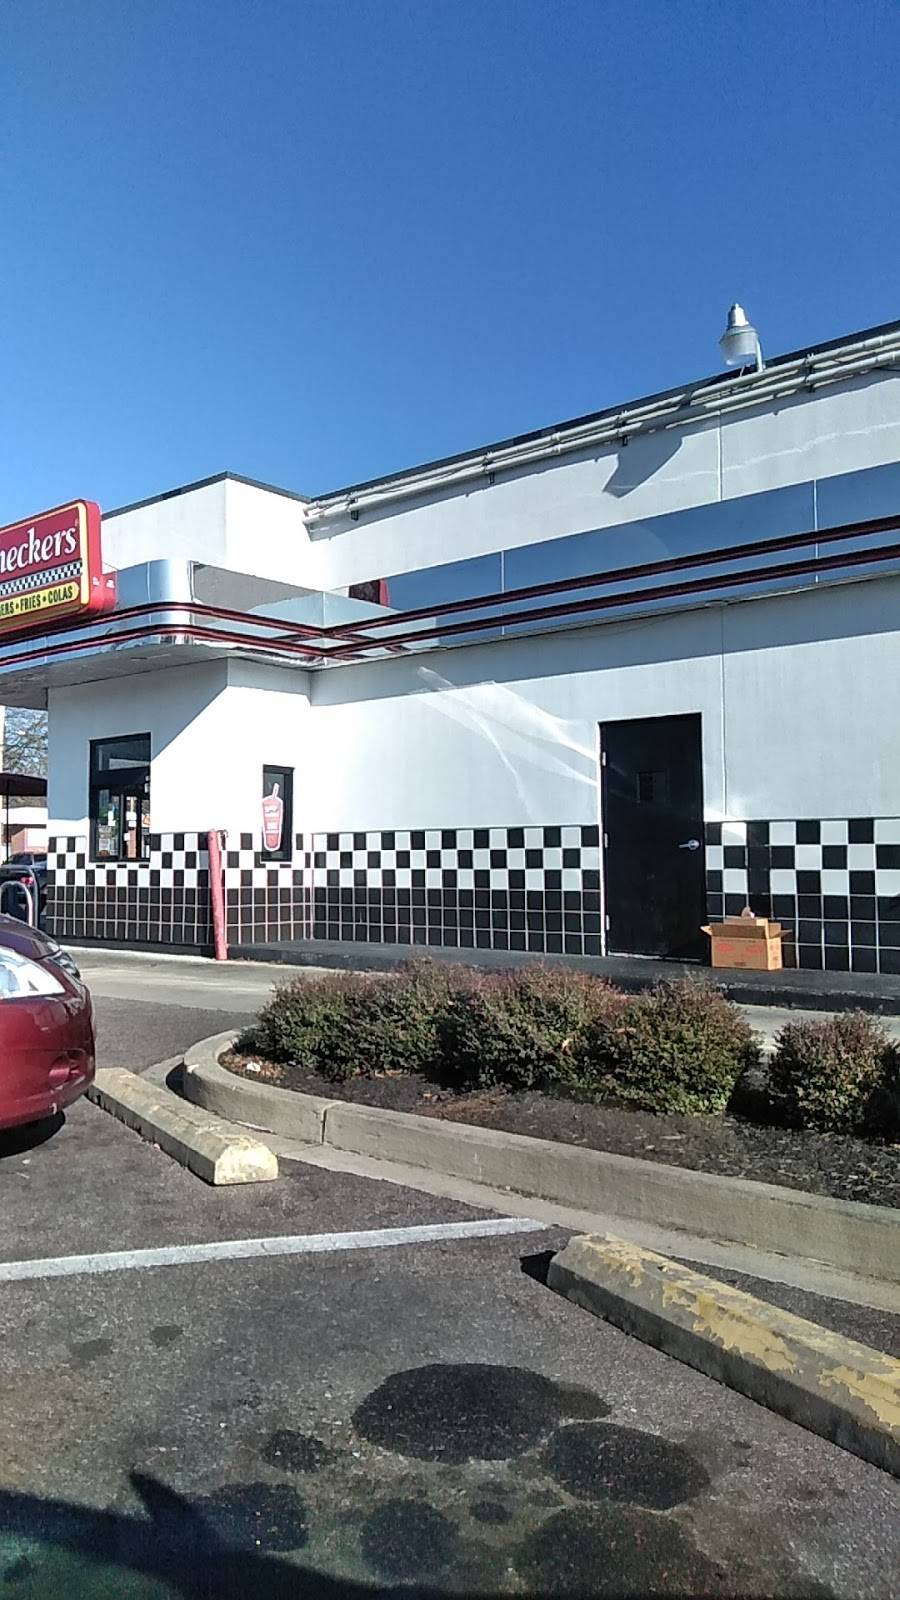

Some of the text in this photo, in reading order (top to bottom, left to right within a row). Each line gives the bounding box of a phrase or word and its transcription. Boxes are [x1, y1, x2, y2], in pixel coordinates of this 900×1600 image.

[0, 585, 73, 616] ERS FRIES COLAS
